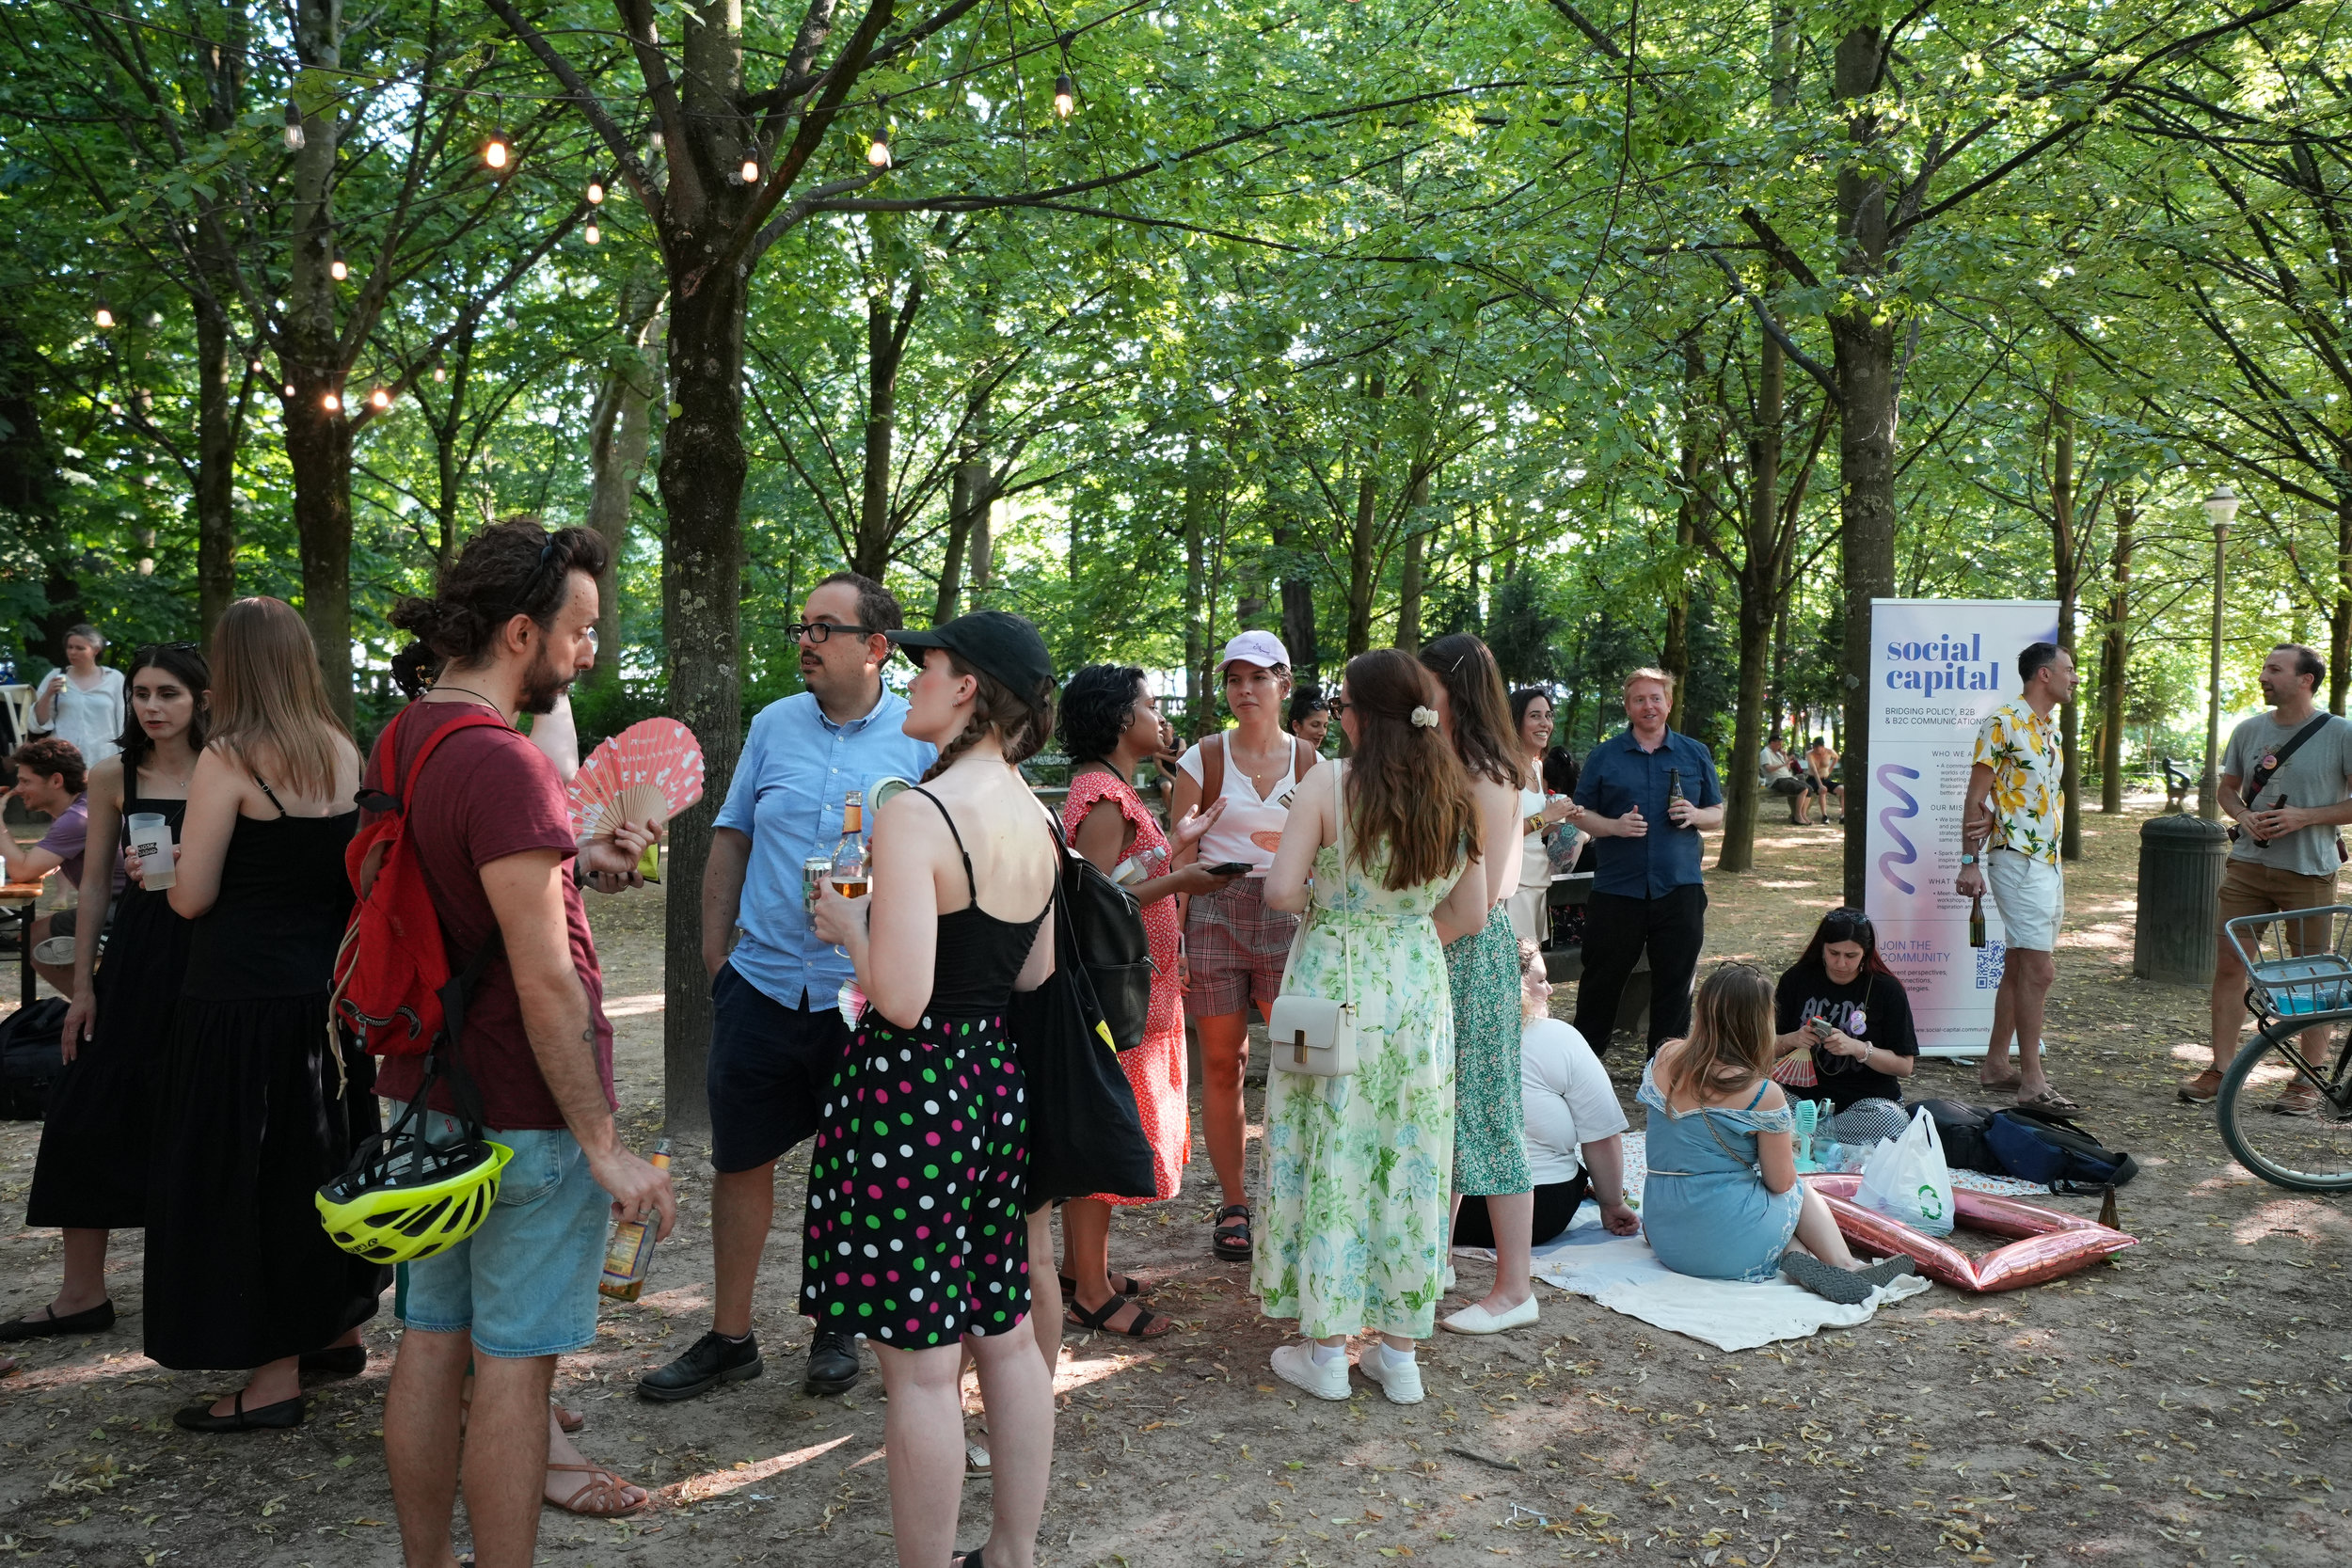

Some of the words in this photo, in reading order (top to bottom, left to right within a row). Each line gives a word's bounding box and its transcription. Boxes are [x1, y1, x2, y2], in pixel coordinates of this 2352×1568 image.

[1887, 633, 1981, 661] social
[1885, 662, 2000, 698] capital
[1885, 707, 1924, 716] BRIDGING
[1926, 707, 1957, 717] POLICY,
[1880, 941, 1906, 950] JOIN
[1910, 941, 1931, 950] THE
[1880, 953, 1950, 962] COMMUNITY
